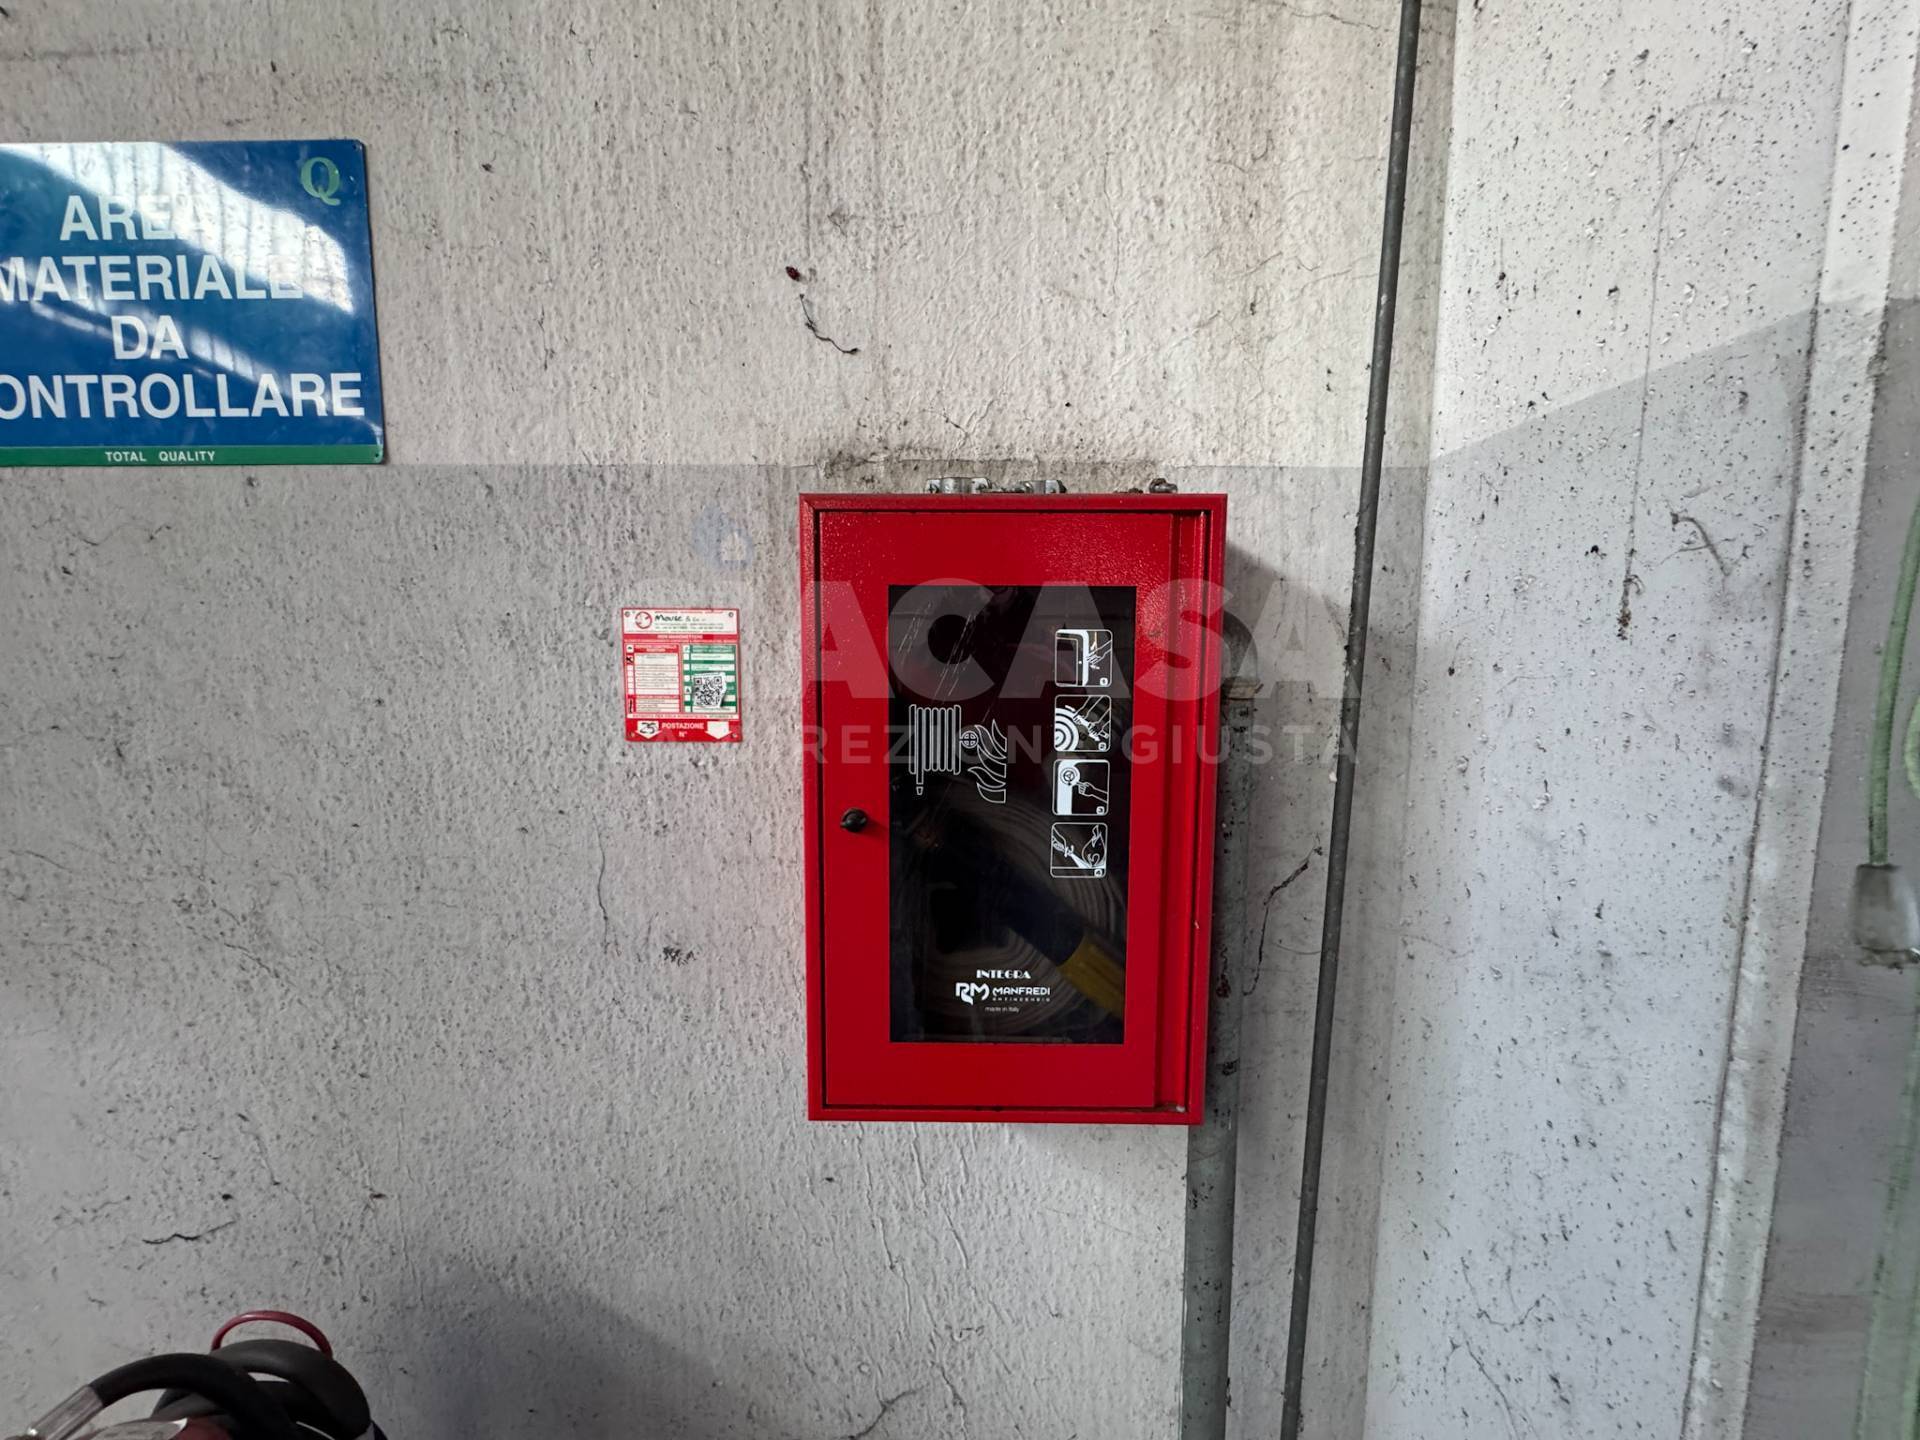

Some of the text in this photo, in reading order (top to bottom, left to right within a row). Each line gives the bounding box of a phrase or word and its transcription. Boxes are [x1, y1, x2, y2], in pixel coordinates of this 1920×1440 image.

[299, 156, 342, 206] Q
[60, 194, 202, 241] ARE
[0, 255, 304, 301] MATERIALE
[111, 315, 188, 360] DA
[105, 451, 216, 463] TOTAL QUALITY
[661, 722, 705, 730] POSTAZIONE
[976, 969, 1031, 979] INTEGRA
[992, 986, 1051, 996] MANFREDI
